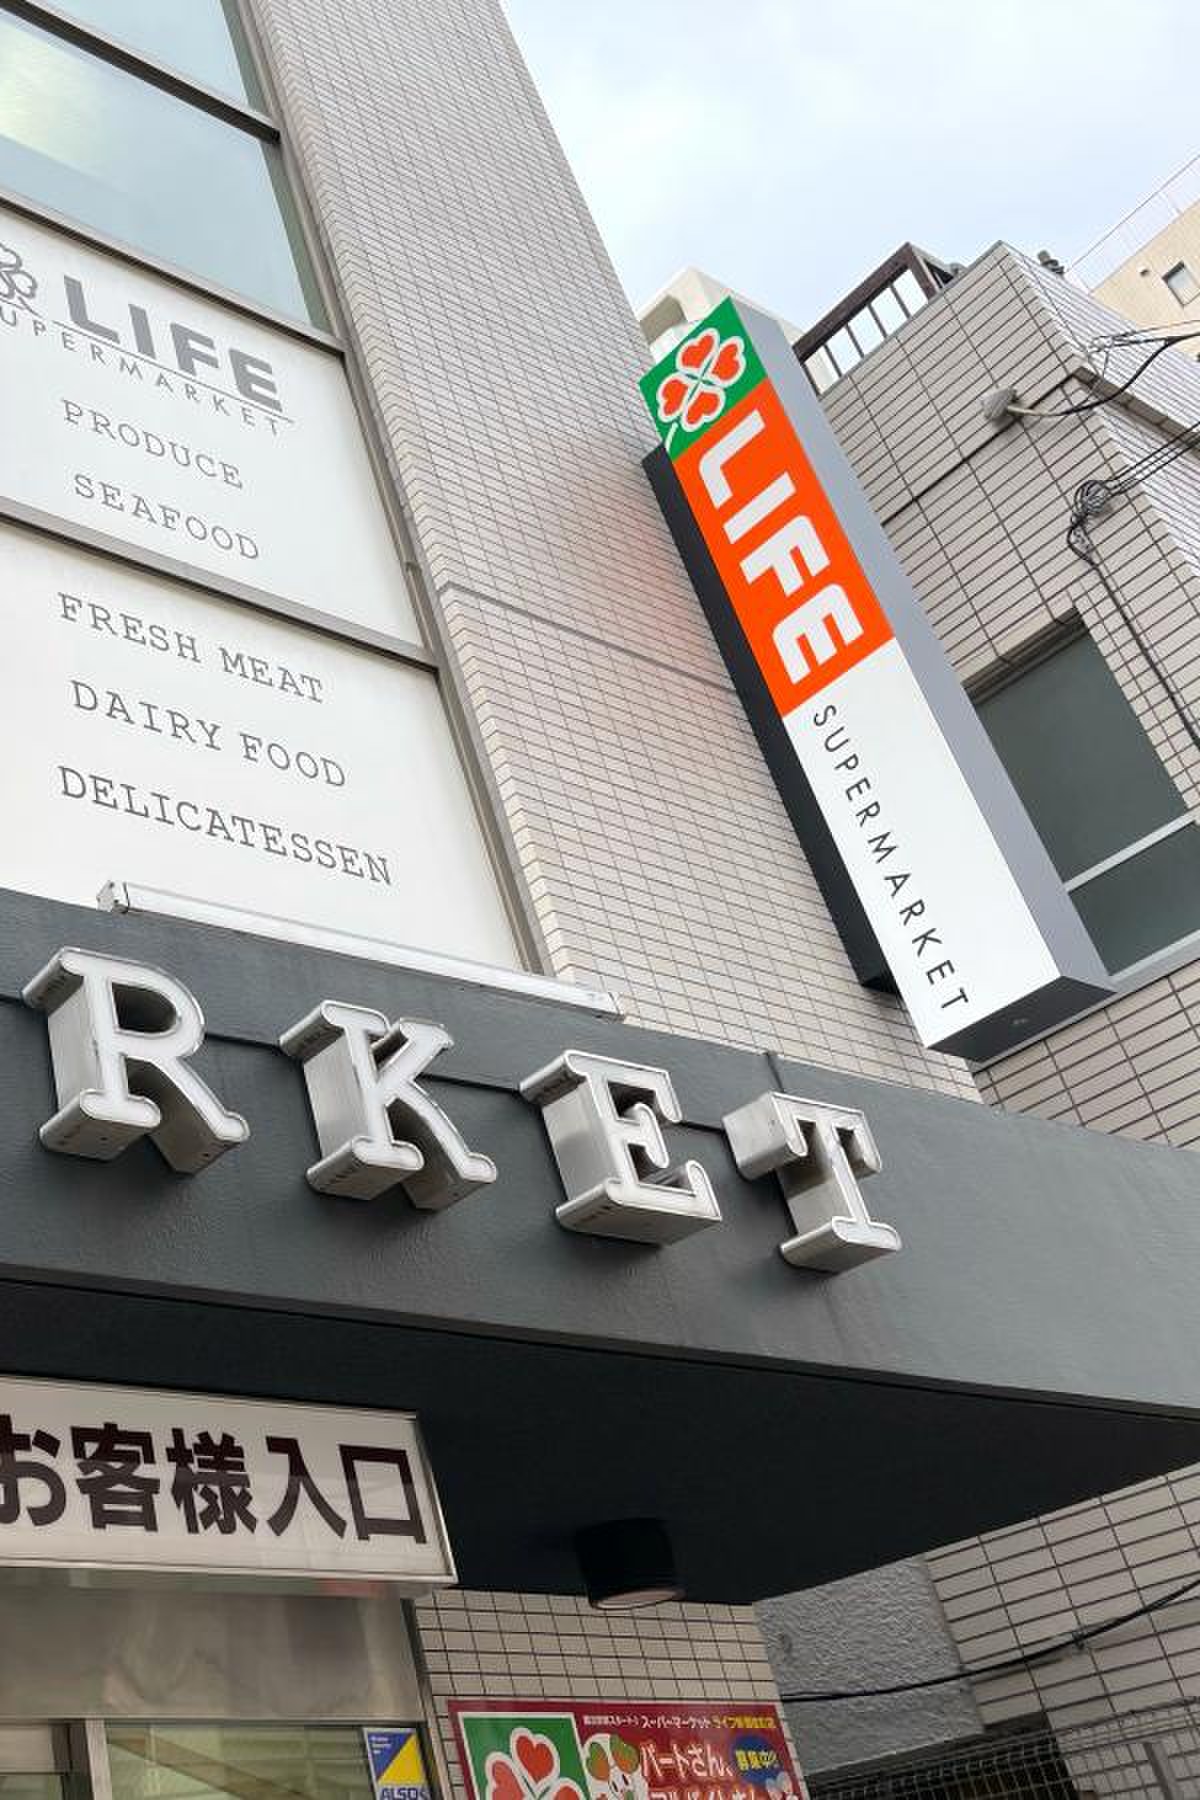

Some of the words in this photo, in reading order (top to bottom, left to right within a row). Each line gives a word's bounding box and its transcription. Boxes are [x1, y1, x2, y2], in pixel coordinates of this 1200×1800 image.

[63, 274, 283, 413] LIFE
[61, 399, 243, 489] PRODUCE
[74, 473, 259, 560] SEAFOOD
[698, 408, 865, 685] LIFE
[58, 591, 201, 664] FRESH
[219, 647, 323, 703] MEAT
[71, 679, 222, 751] DAIRY
[239, 731, 346, 787] FOOD
[58, 765, 393, 887] DELICATESSEN
[813, 704, 970, 1012] SUPERMARKET
